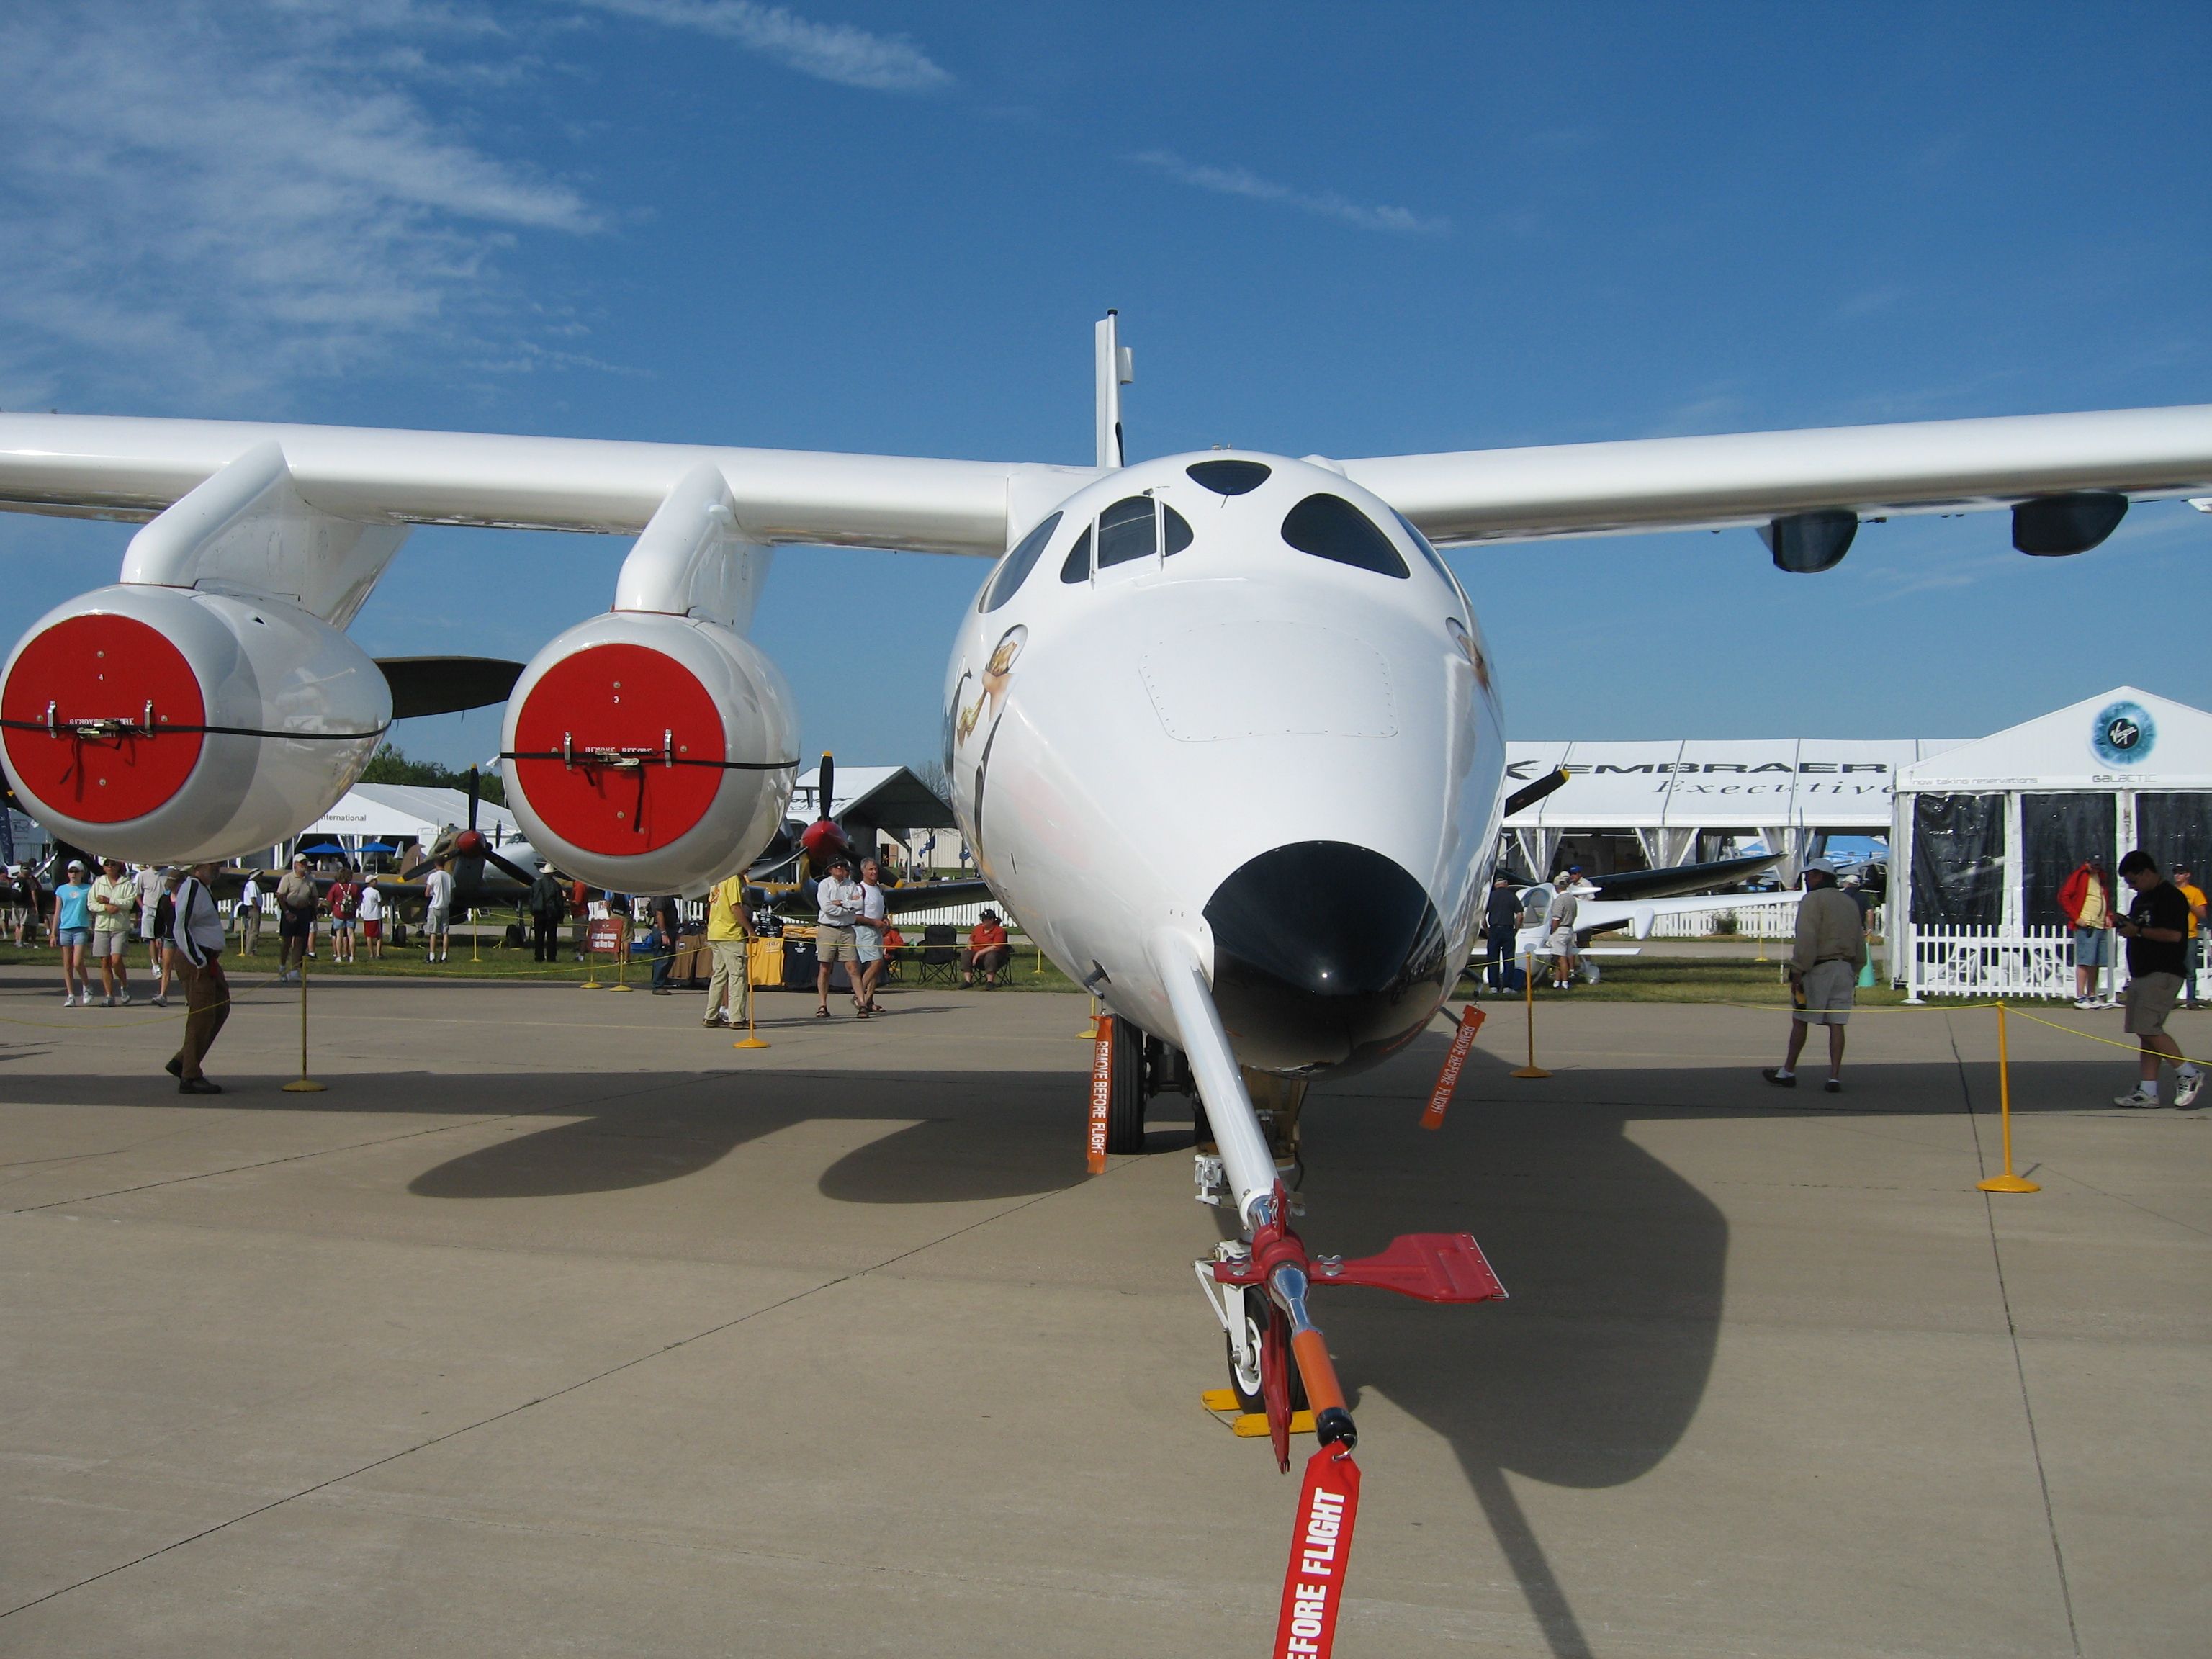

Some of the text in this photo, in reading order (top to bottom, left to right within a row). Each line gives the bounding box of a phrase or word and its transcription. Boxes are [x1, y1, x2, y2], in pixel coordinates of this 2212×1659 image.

[1553, 762, 1887, 774] EMBRAER
[2110, 721, 2137, 745] Virgin
[1091, 1040, 1109, 1156] REMOVE BEFORE FLIGHT
[1431, 1023, 1475, 1114] REMOVE BEFORE FLIGHT
[1301, 1487, 1345, 1575] FLIGHT
